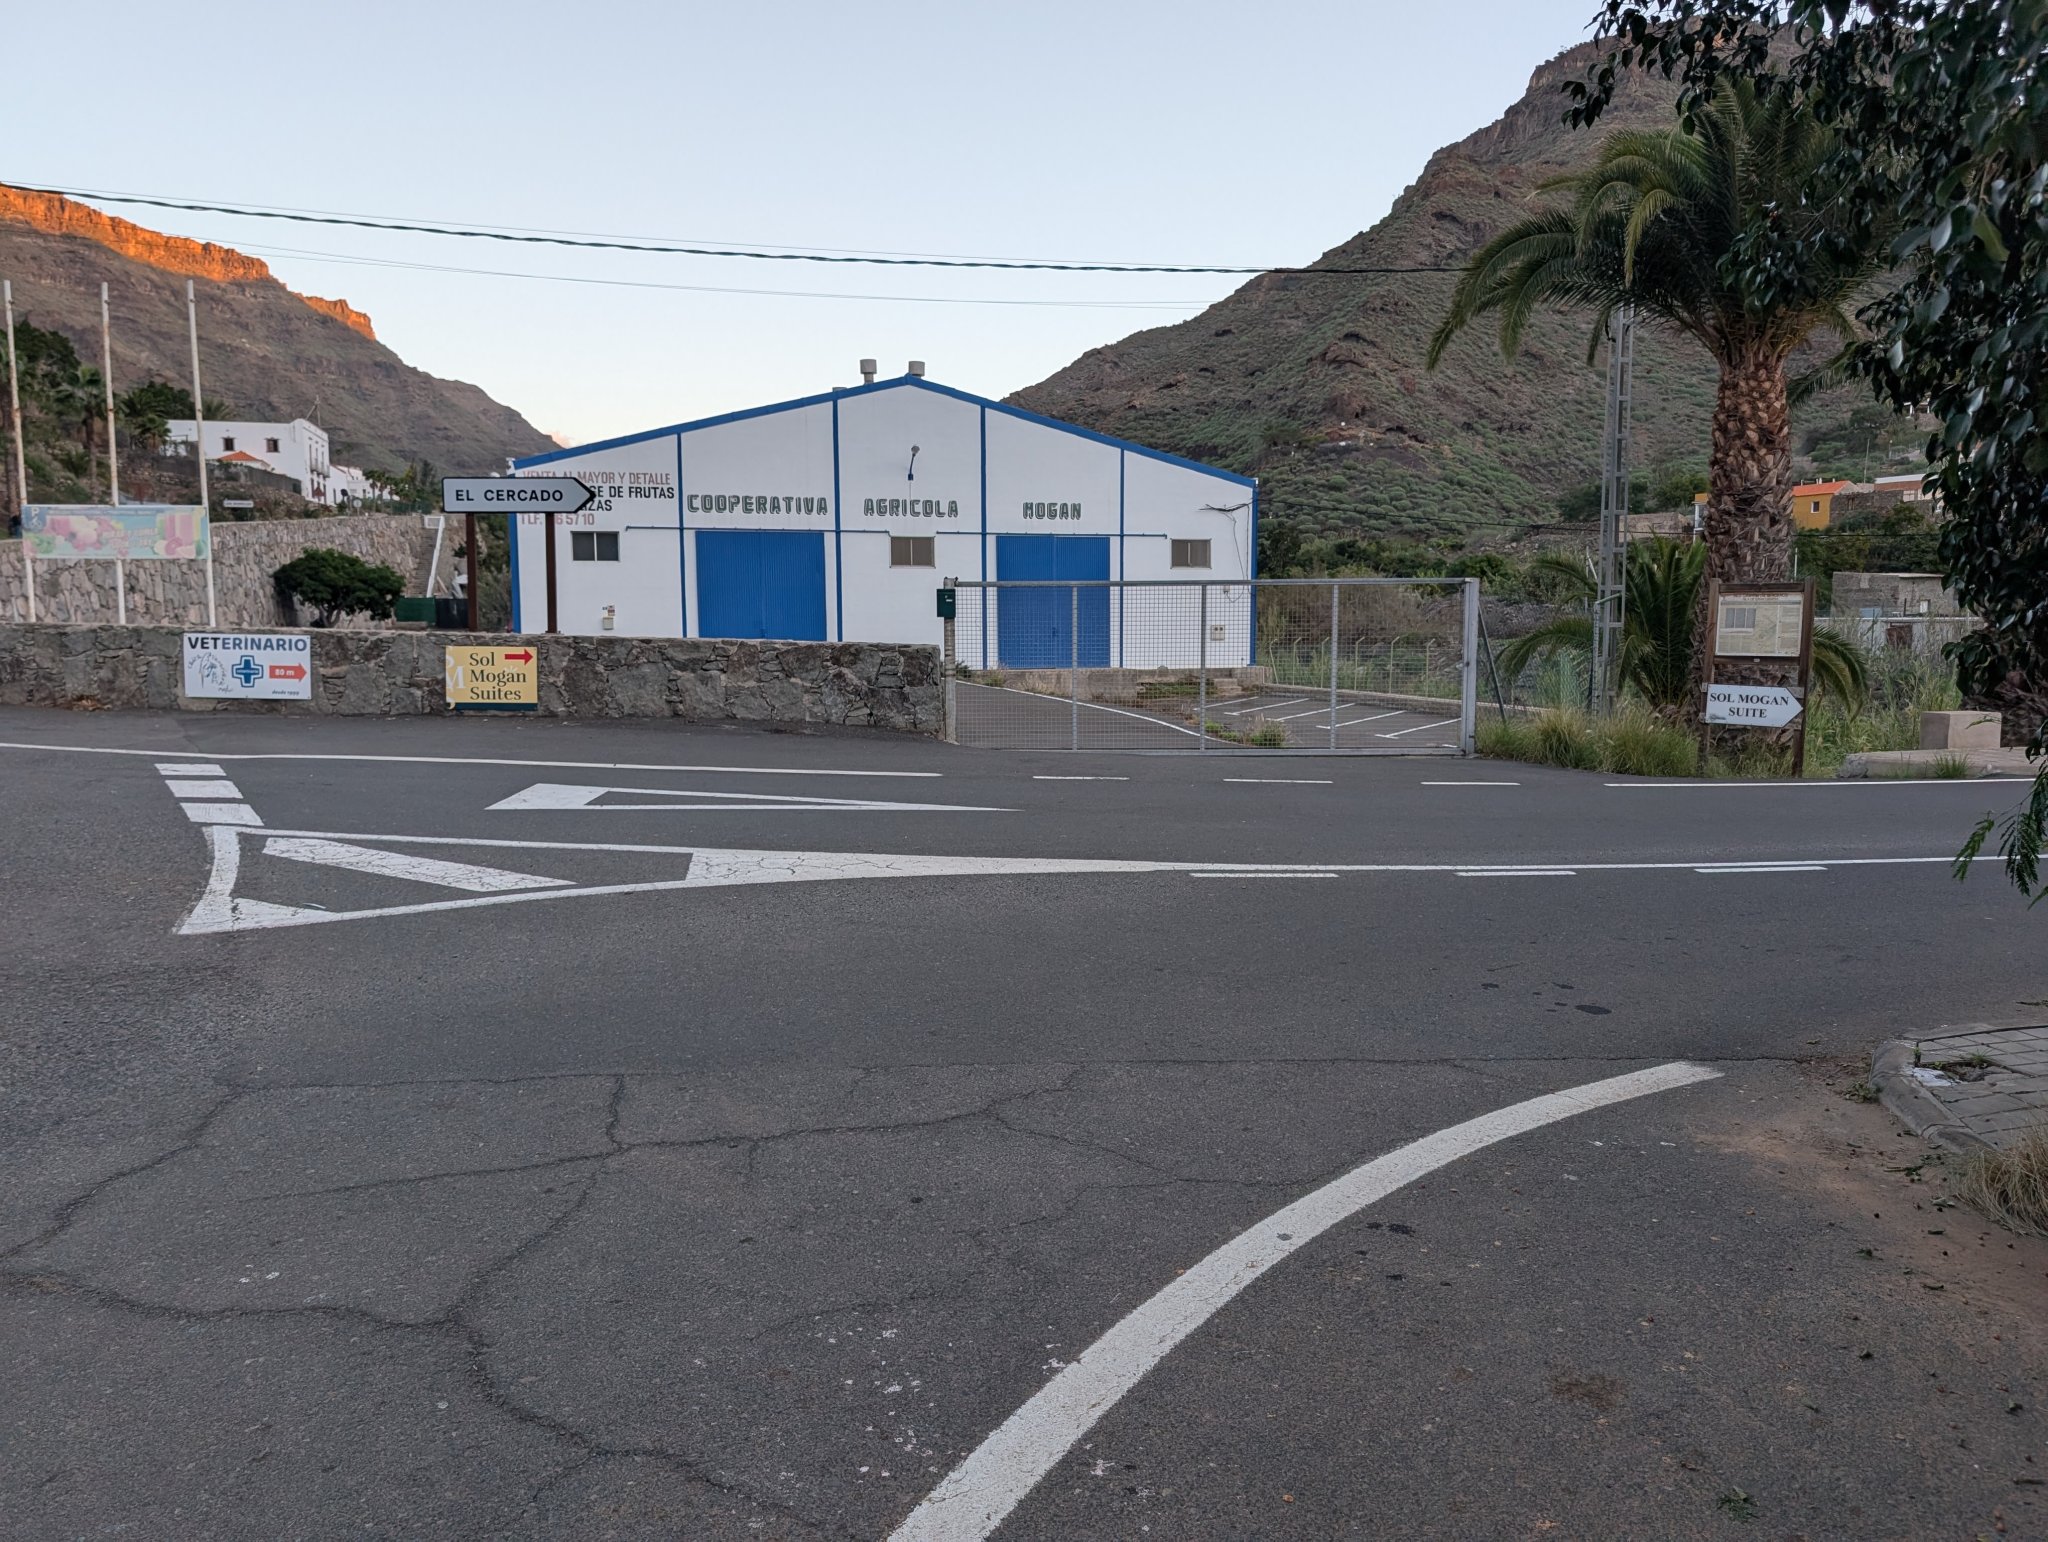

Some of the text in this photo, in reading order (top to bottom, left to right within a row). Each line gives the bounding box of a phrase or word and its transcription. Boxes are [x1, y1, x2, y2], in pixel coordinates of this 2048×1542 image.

[577, 471, 615, 484] MAYOR
[618, 472, 626, 484] Y
[629, 472, 671, 485] DETALLE
[455, 489, 564, 502] EL CERCADO
[609, 486, 624, 498] DE
[628, 486, 675, 499] FRUTAS
[687, 494, 1082, 520] COOPERATIVA AGRICOLA MOGAN
[187, 636, 308, 652] VETERINARIO
[469, 651, 495, 667] Sol
[469, 669, 527, 687] Mogan
[469, 686, 522, 701] Suites
[1709, 692, 1790, 706] SOL MOGAN
[1728, 706, 1768, 719] SUITE
